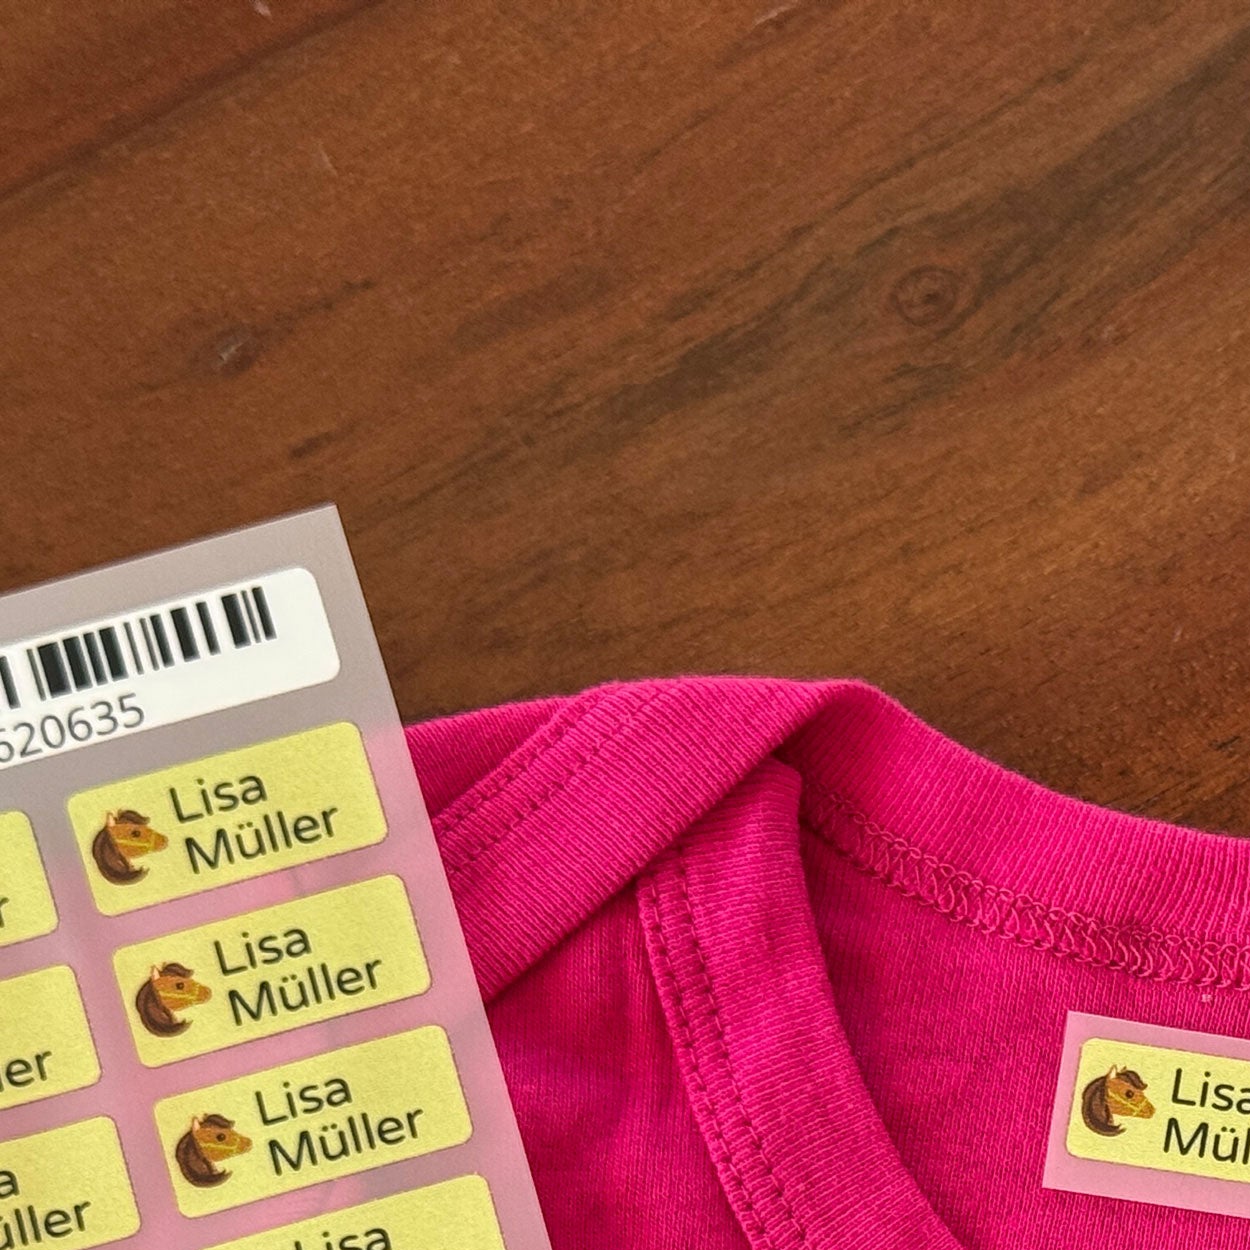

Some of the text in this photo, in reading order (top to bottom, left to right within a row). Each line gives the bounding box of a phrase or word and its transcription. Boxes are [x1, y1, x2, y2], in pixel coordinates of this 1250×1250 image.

[168, 774, 267, 824] Lisa
[184, 800, 339, 875] Müller
[213, 927, 312, 977] Lisa
[227, 957, 383, 1027] Müller
[254, 1077, 353, 1126] Lisa
[267, 1108, 424, 1176] Müller
